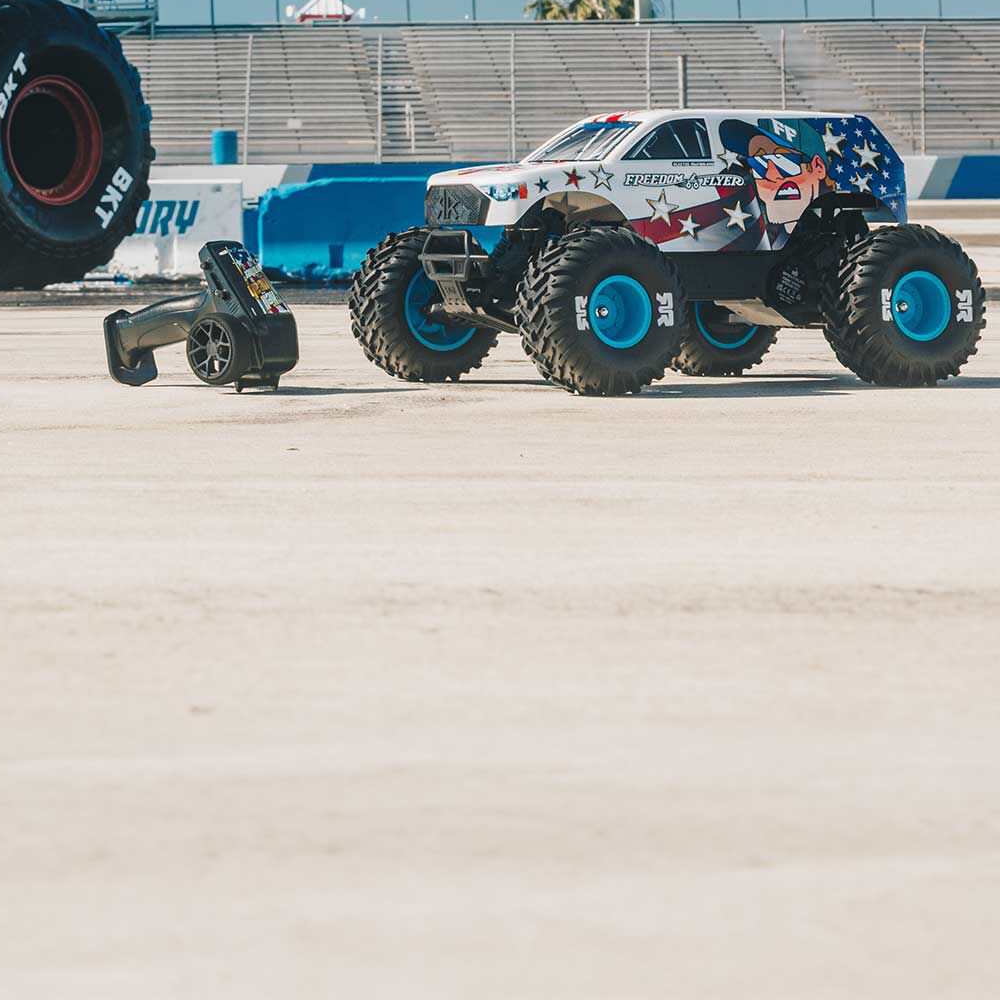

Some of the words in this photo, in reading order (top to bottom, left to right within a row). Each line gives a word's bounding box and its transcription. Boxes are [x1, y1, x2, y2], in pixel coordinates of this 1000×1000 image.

[771, 118, 797, 142] FF
[624, 173, 685, 188] FREEDOM
[700, 174, 745, 188] FLYER
[95, 166, 134, 229] BKT
